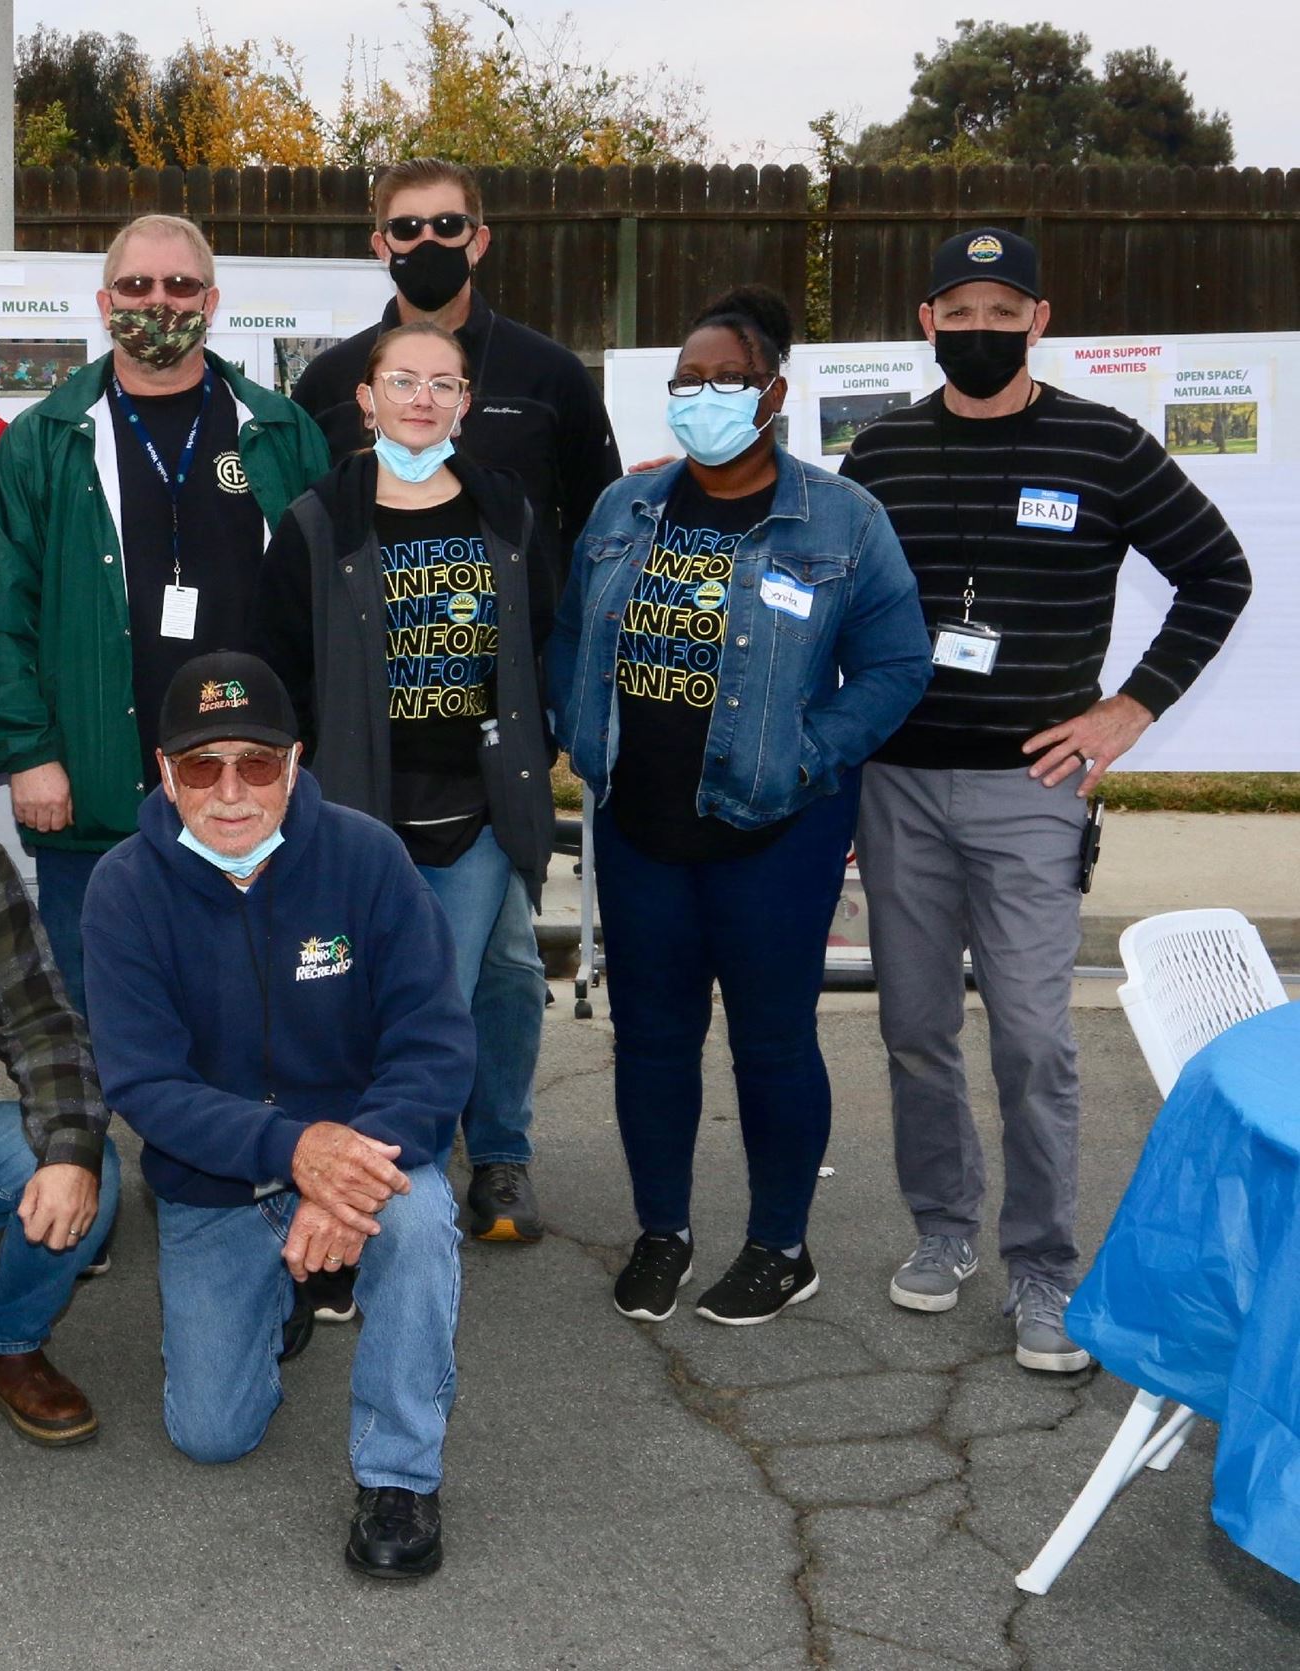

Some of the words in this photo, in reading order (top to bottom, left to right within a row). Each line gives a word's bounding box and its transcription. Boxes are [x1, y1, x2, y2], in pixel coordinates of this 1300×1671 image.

[1, 300, 70, 313] MURALS
[229, 316, 297, 328] MODERN
[1074, 349, 1111, 360] MAJOR
[1112, 346, 1162, 358] SUPPORT
[819, 363, 890, 374] LANDSCAPING
[892, 362, 913, 372] AND
[1089, 363, 1147, 374] AMENITIES
[1176, 371, 1204, 382] OPEN
[1207, 369, 1249, 382] SPACE/
[843, 378, 890, 389] LIGHTING
[1174, 386, 1221, 397] NATURAL
[1224, 385, 1252, 395] AREA
[1021, 501, 1074, 522] BRAD
[295, 957, 353, 982] RECREATIO
